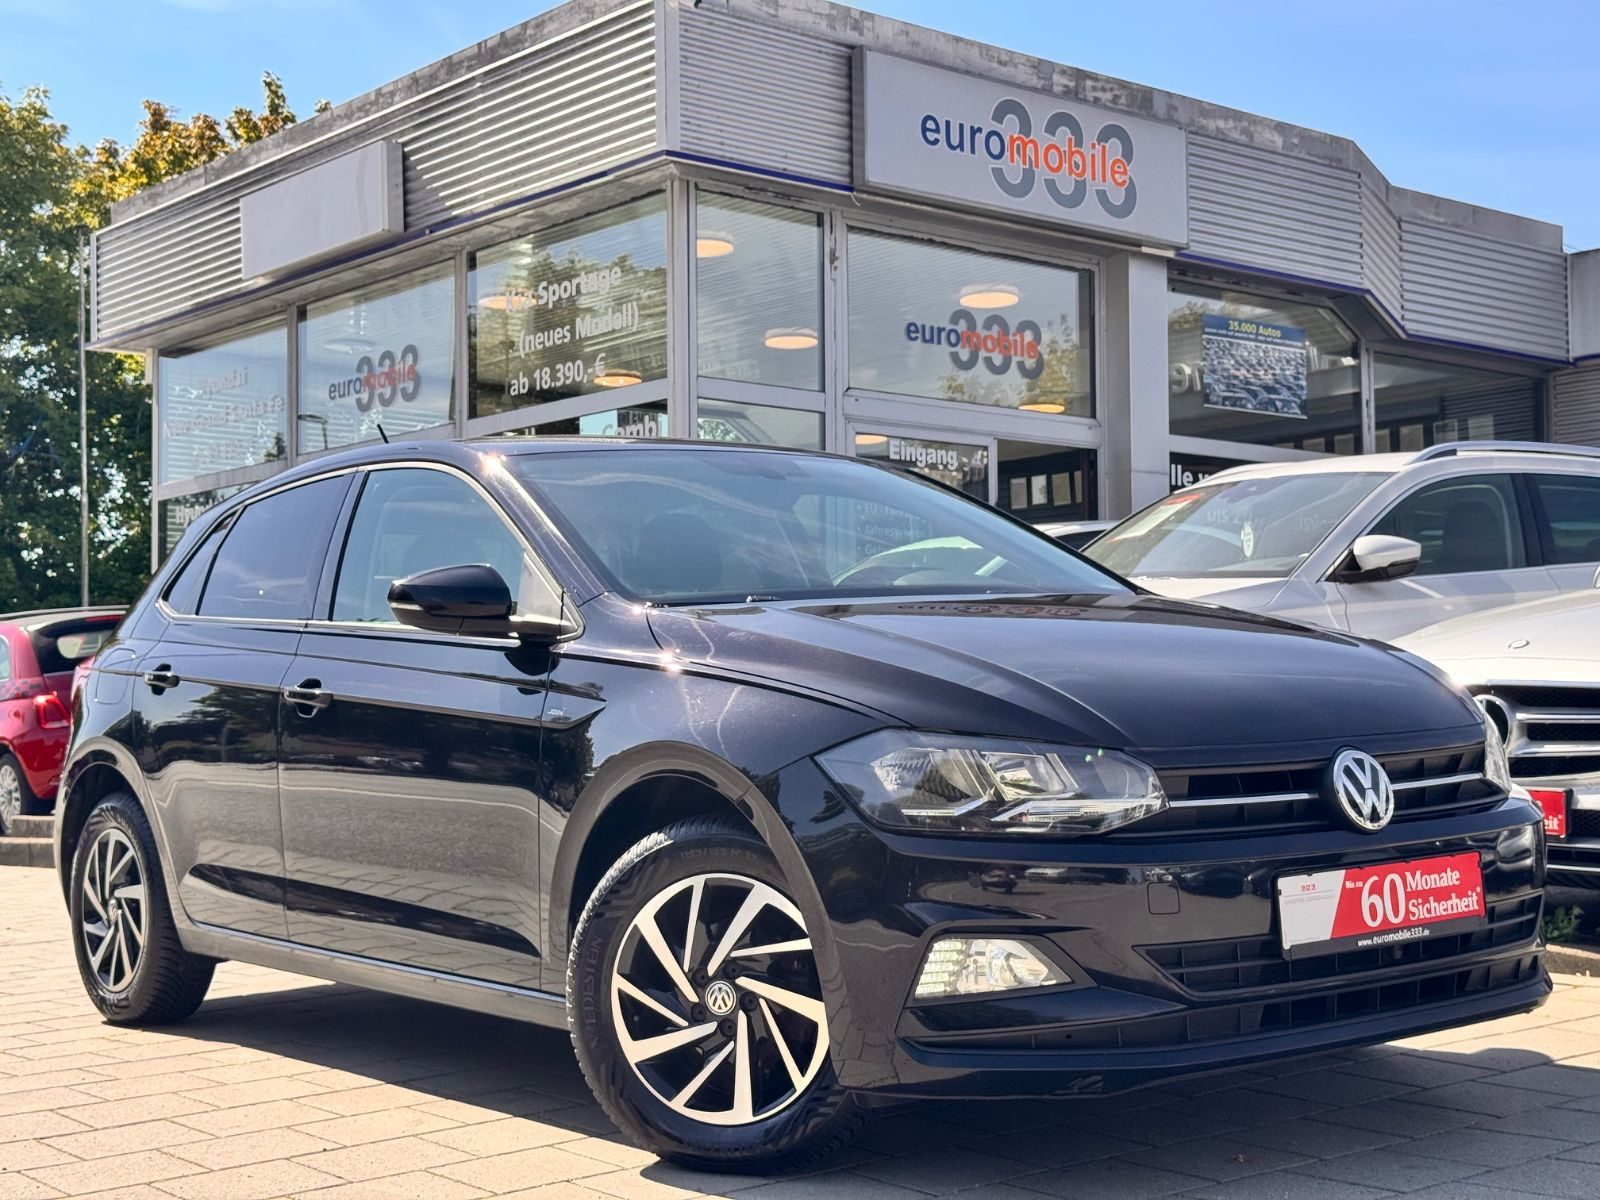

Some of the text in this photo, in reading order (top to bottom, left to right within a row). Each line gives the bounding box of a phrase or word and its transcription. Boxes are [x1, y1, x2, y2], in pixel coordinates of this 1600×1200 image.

[920, 114, 1128, 188] euromobile
[990, 98, 1137, 219] 333
[537, 266, 622, 309] Sportage
[518, 301, 639, 358] (neues Modell)
[906, 321, 1039, 360] euromobile
[1228, 320, 1257, 333] 35.000
[1258, 325, 1282, 338] Autos
[328, 358, 417, 401] euromobile
[510, 371, 529, 396] ab
[889, 439, 958, 471] Eingang
[1361, 873, 1406, 928] 60
[1404, 867, 1461, 892] Monate
[1358, 927, 1430, 947] www.euromobile333.de
